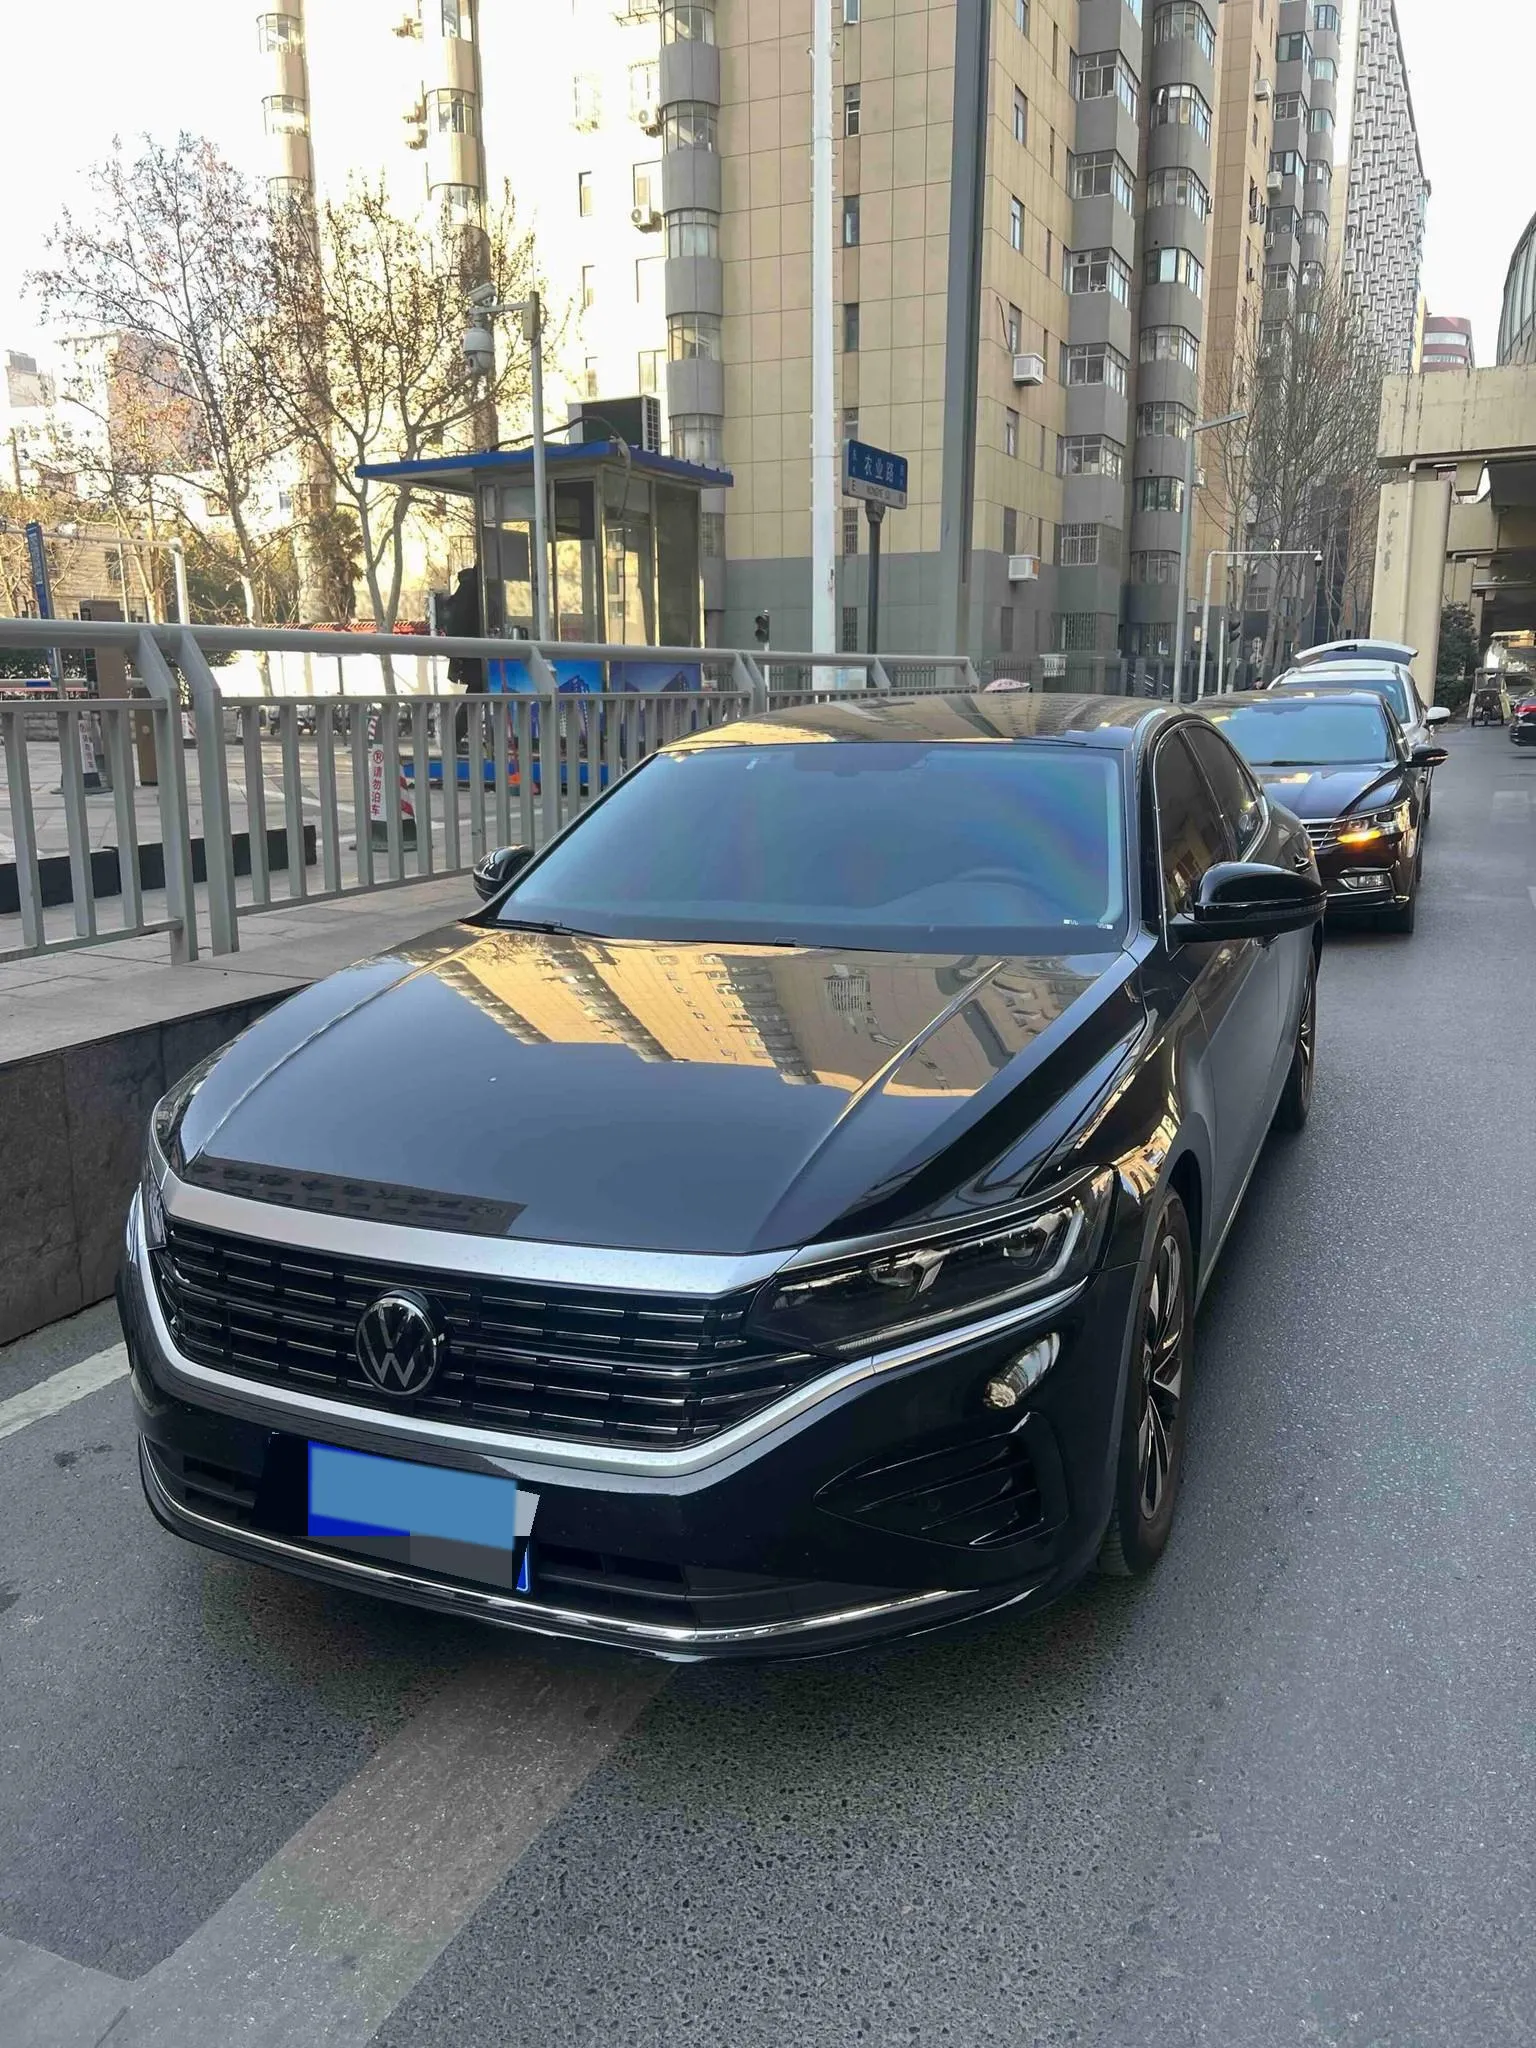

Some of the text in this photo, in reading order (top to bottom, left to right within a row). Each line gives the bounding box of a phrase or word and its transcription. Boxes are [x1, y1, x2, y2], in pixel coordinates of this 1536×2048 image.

[864, 455, 894, 482] 农业路
[371, 766, 382, 815] 请勿泊车
